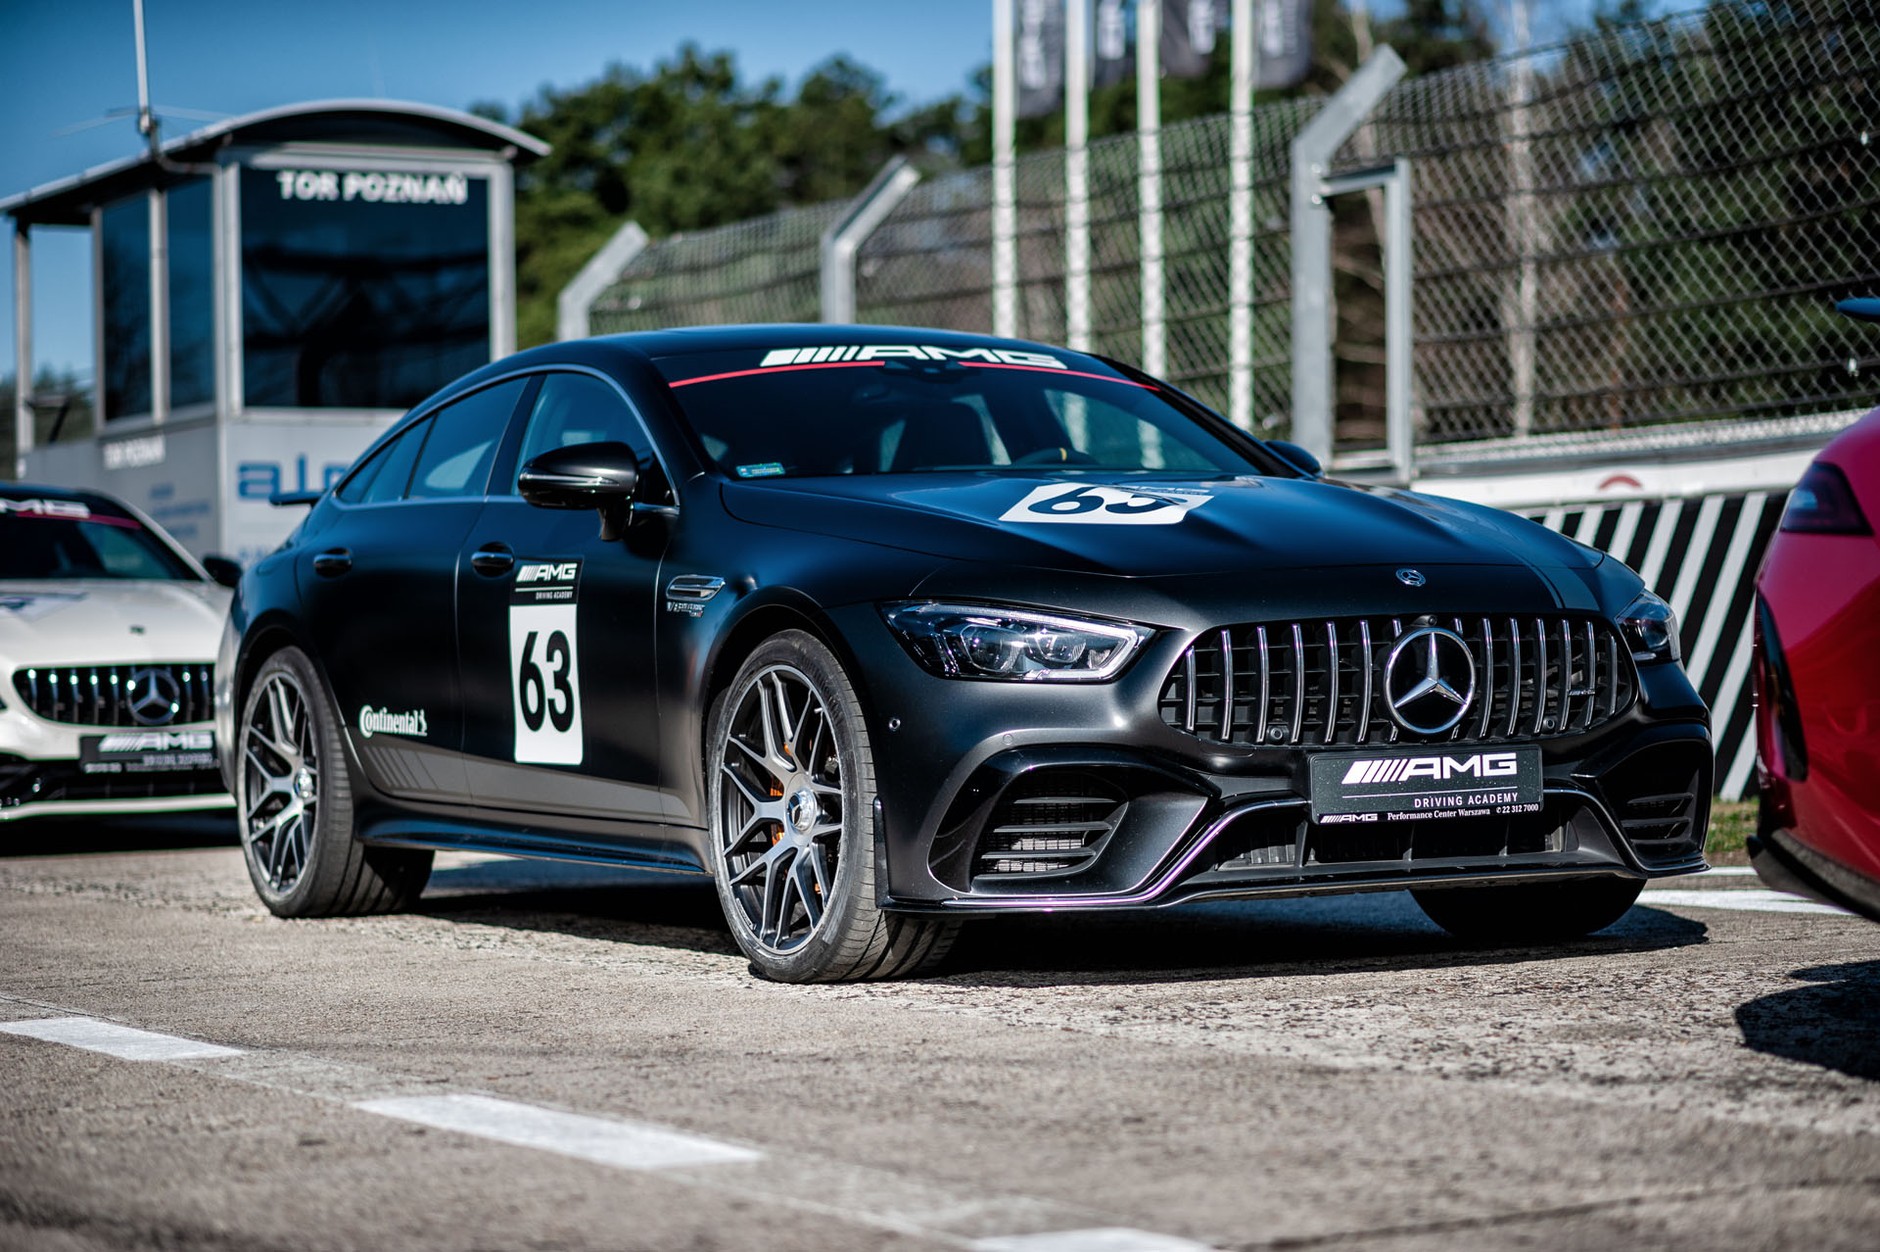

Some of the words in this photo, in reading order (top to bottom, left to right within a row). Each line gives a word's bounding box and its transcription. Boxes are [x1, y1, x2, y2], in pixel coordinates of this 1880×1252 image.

[277, 169, 339, 200] TOR
[342, 169, 468, 205] POZNAŃ
[856, 345, 1067, 370] AMG
[534, 563, 577, 582] AMG
[535, 591, 553, 600] DRIVING
[553, 591, 573, 600] ACADEMY
[519, 629, 574, 733] 63
[359, 704, 419, 738] Continental
[1398, 752, 1518, 782] AMG
[1414, 795, 1463, 808] DRIVING
[1467, 792, 1518, 805] ACADEMY
[1339, 813, 1378, 823] AMG
[1387, 811, 1433, 821] Performance
[1433, 809, 1457, 818] Center
[1457, 807, 1491, 816] Warszawa
[1502, 805, 1511, 814] 22
[1511, 804, 1523, 813] 312
[1523, 803, 1539, 812] 7000
